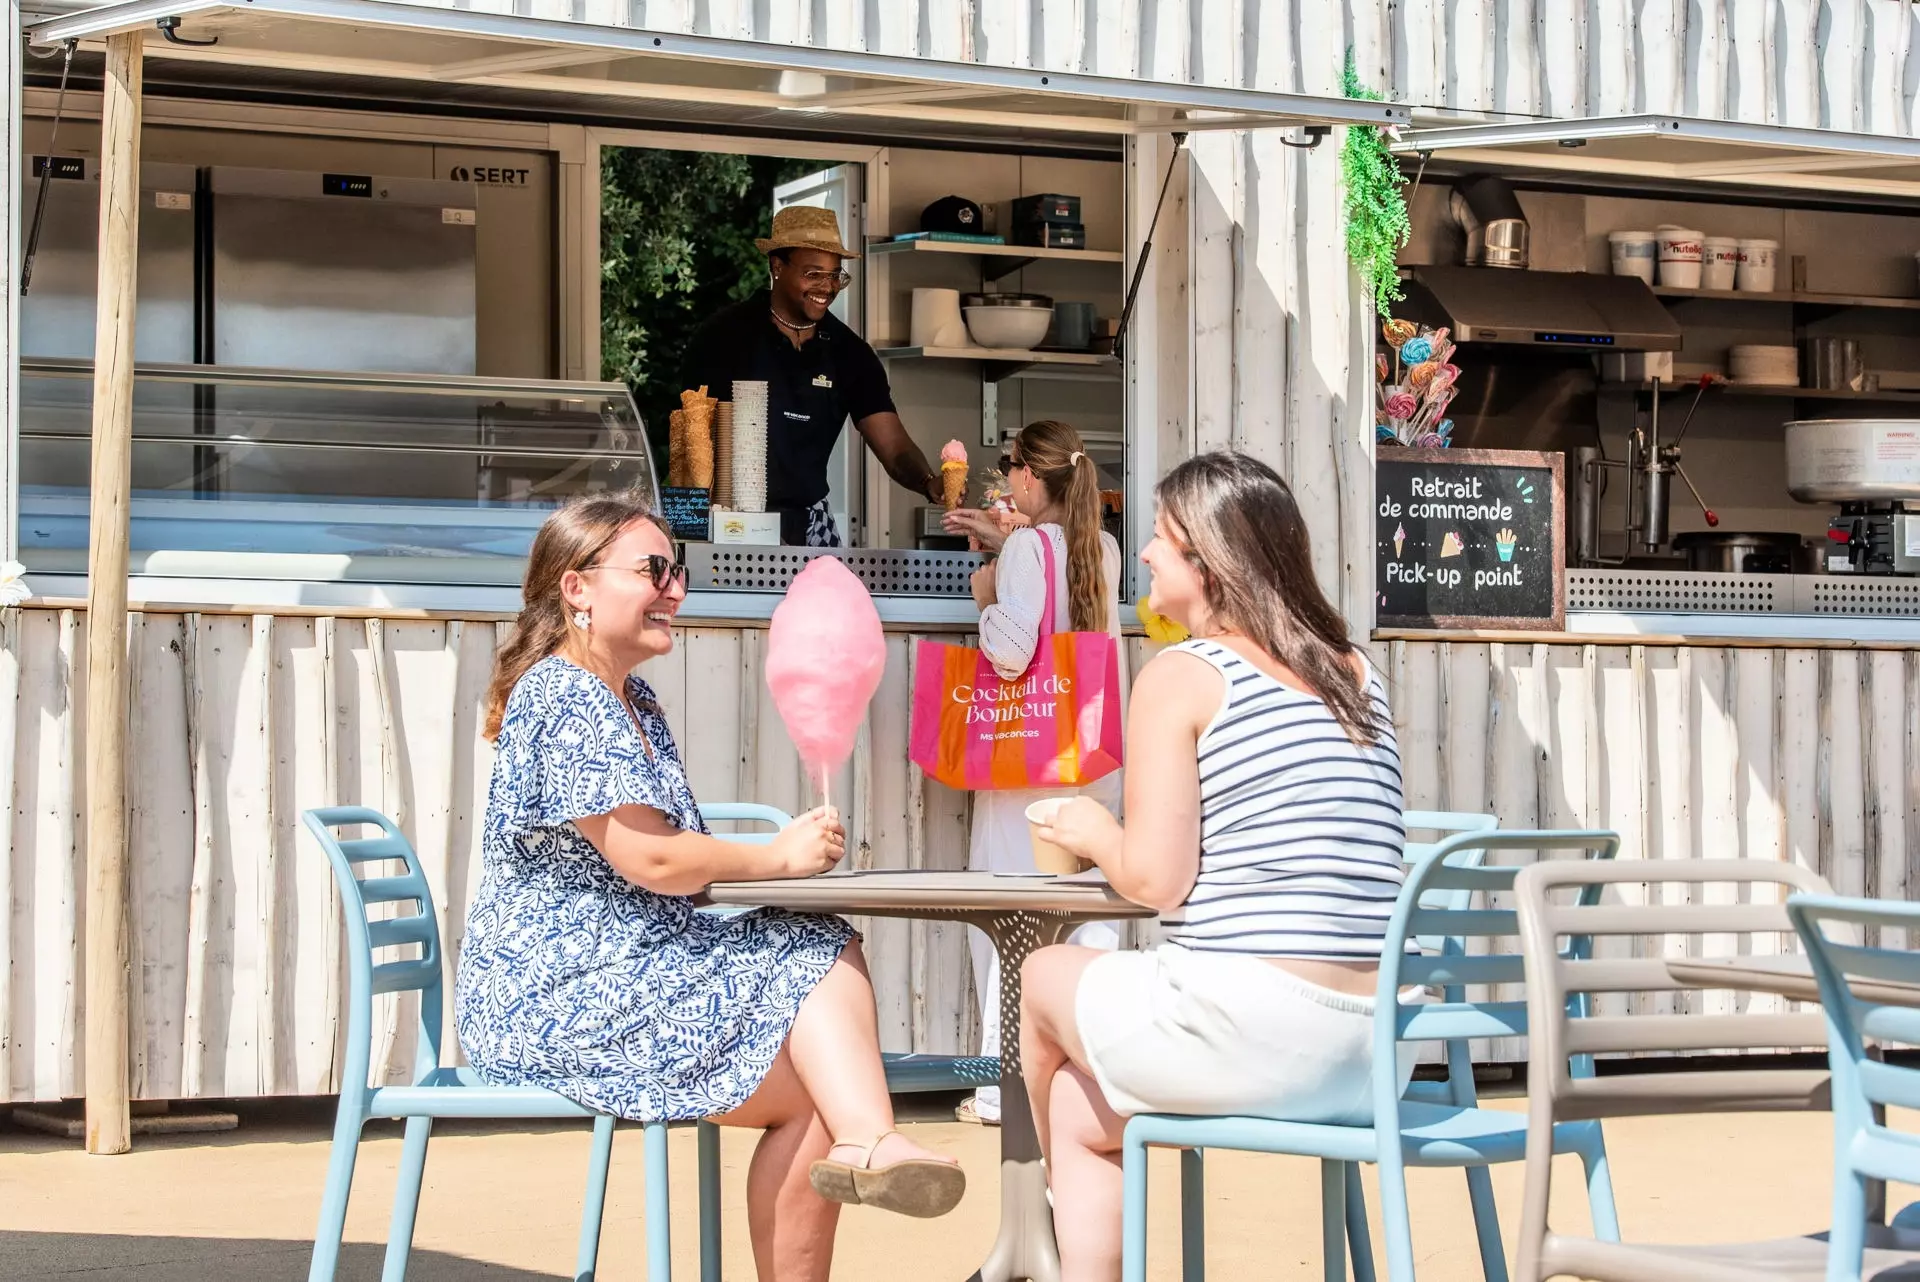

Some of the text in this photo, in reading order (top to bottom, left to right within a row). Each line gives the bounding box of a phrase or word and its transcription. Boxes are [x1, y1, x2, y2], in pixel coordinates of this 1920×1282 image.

[473, 167, 530, 185] SERT
[1411, 476, 1483, 499] Retrait
[1379, 494, 1513, 521] de commande
[1386, 562, 1523, 591] Pick-up point
[952, 674, 1071, 704] Cocktail de
[965, 701, 1057, 724] Bonheur
[994, 729, 1040, 740] vacances
